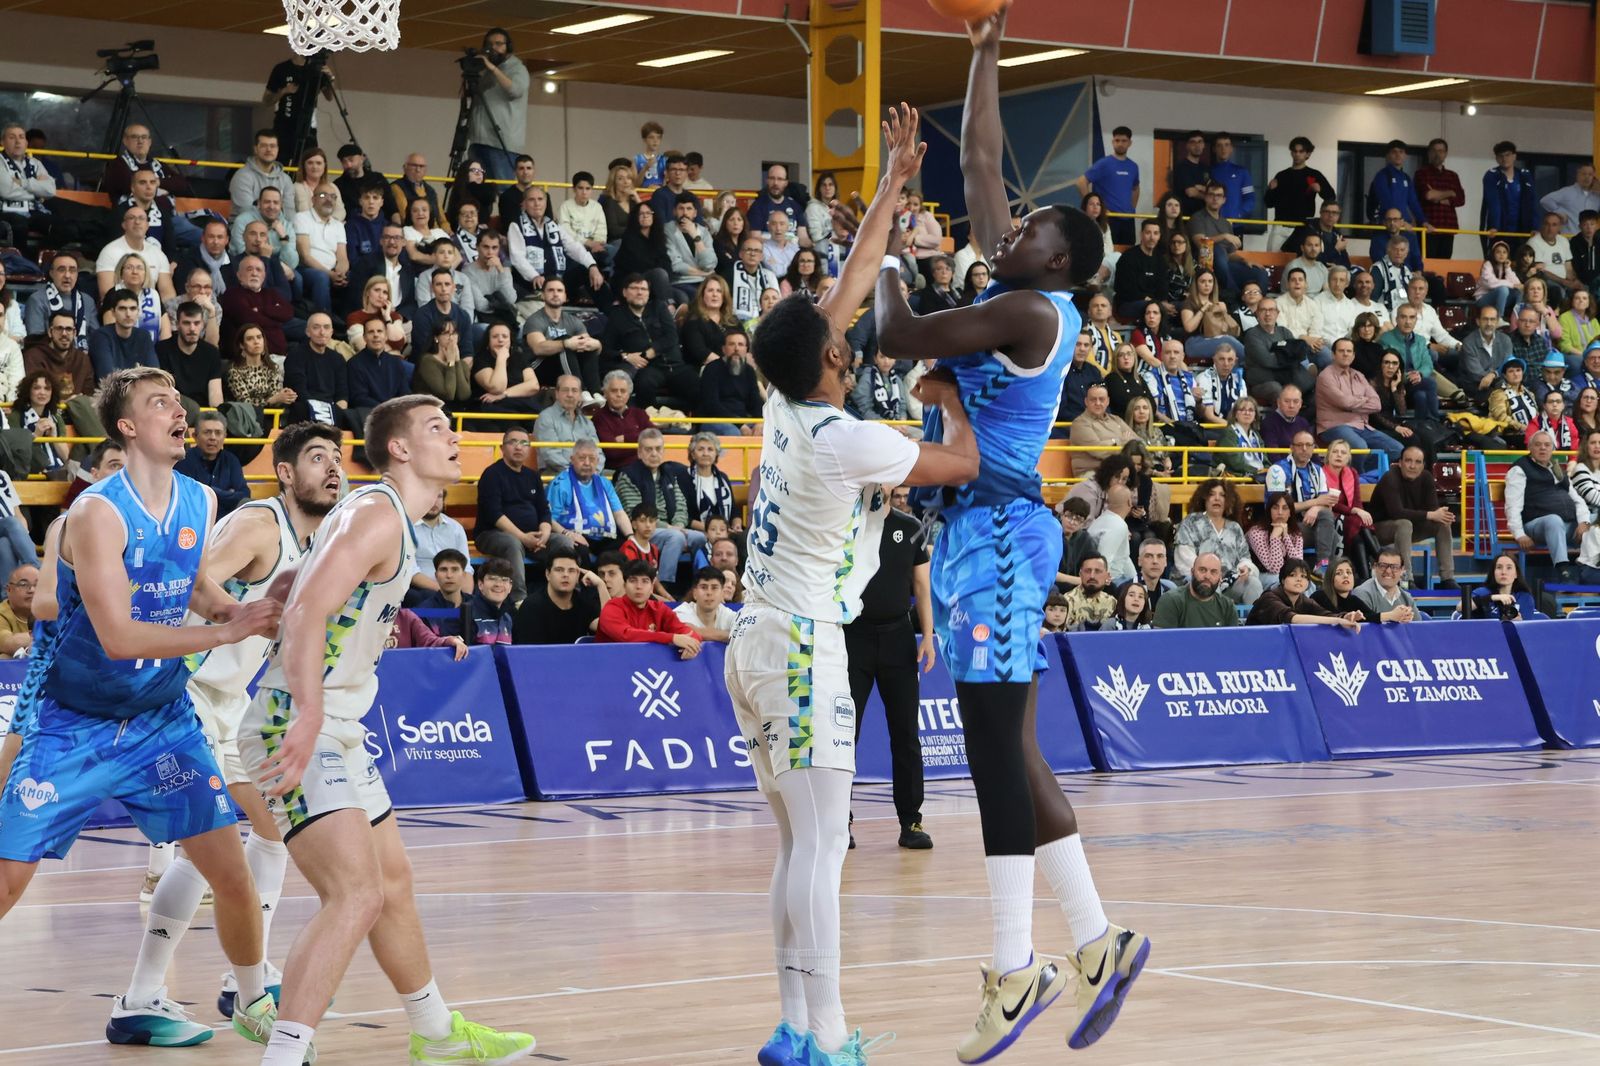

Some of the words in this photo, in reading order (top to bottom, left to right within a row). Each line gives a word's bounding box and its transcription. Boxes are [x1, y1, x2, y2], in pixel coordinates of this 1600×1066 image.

[1376, 660, 1433, 684] CAJA
[1432, 658, 1509, 682] RURAL
[1157, 672, 1217, 697] CAJA
[1216, 669, 1297, 694] RURAL
[1384, 687, 1410, 703] DE
[1413, 685, 1483, 702] ZAMORA
[1165, 701, 1192, 718] DE
[1195, 697, 1269, 717] ZAMORA
[397, 712, 493, 744] Senda
[404, 748, 433, 761] Vivir
[435, 748, 482, 763] seguros.
[12, 783, 59, 804] ZAMORA
